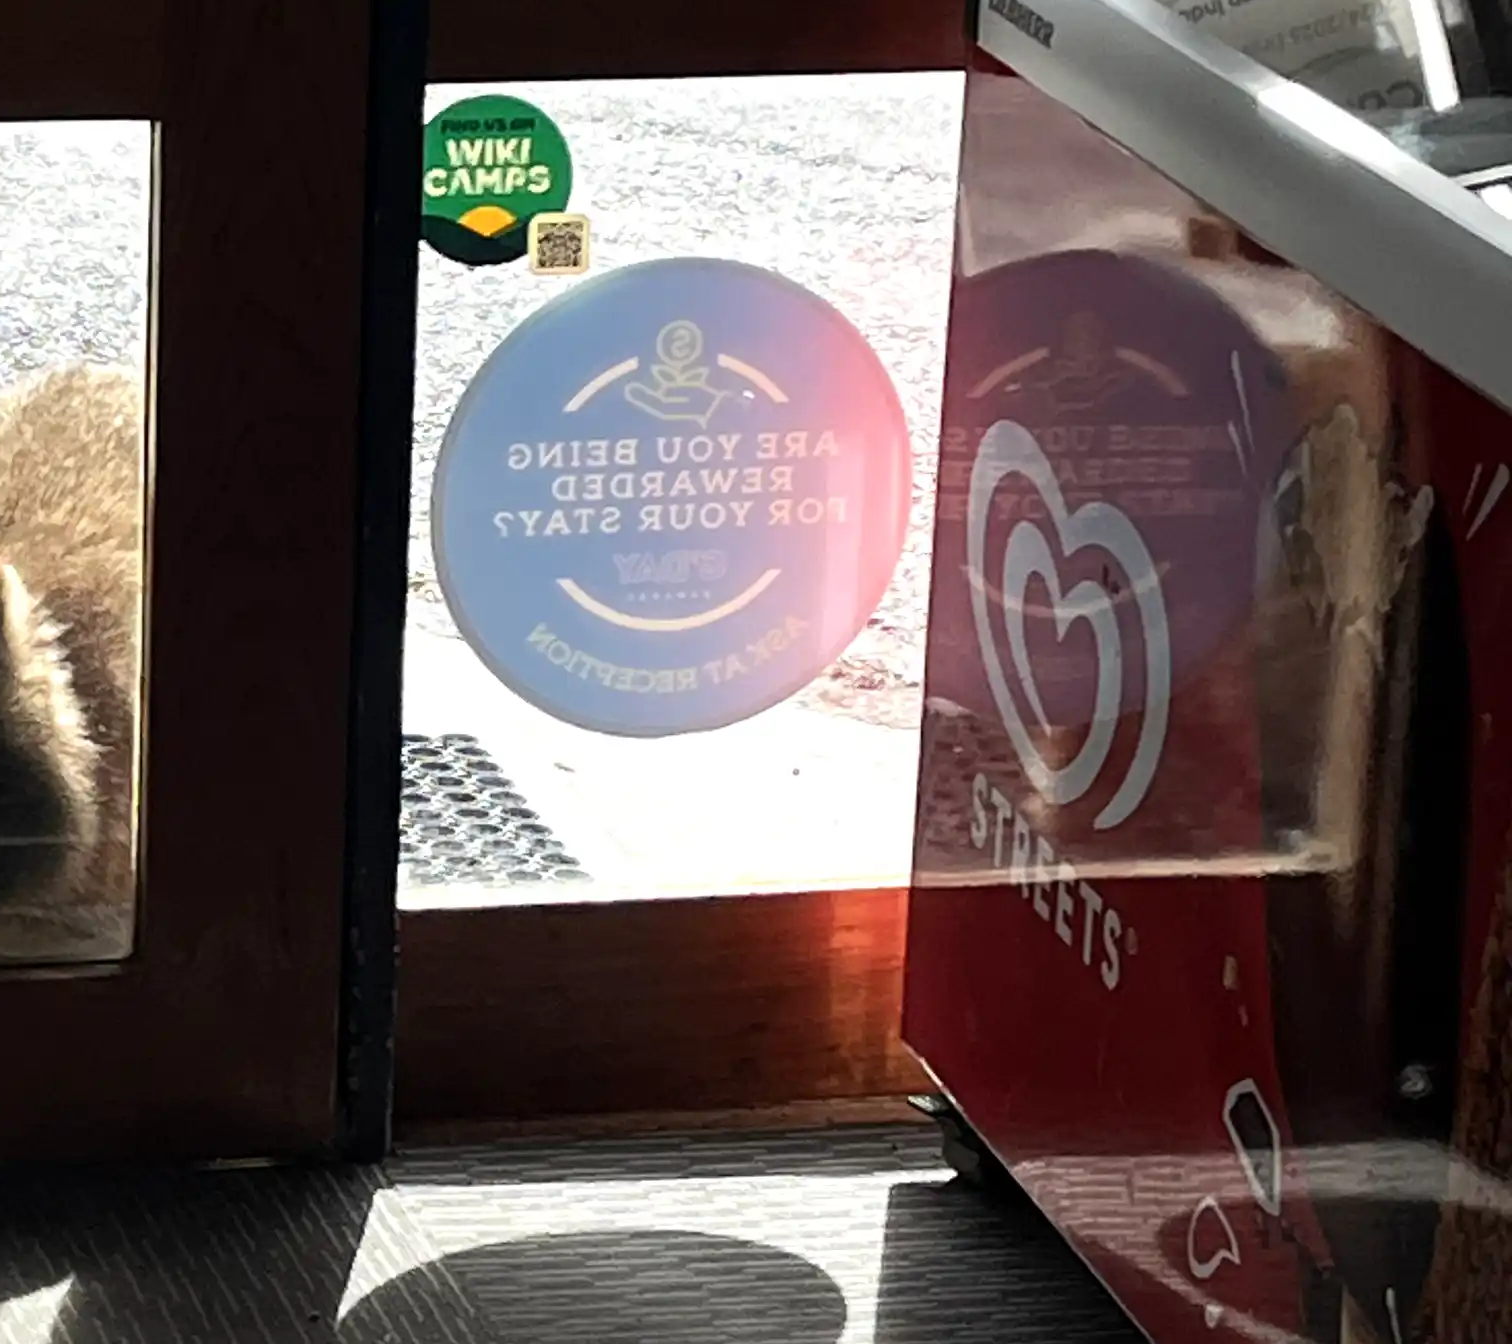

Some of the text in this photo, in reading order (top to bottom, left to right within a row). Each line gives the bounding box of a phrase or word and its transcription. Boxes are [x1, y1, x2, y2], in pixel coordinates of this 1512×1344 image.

[445, 137, 532, 166] WIKI
[423, 164, 552, 197] CAMPS
[970, 772, 1123, 992] STREETS
